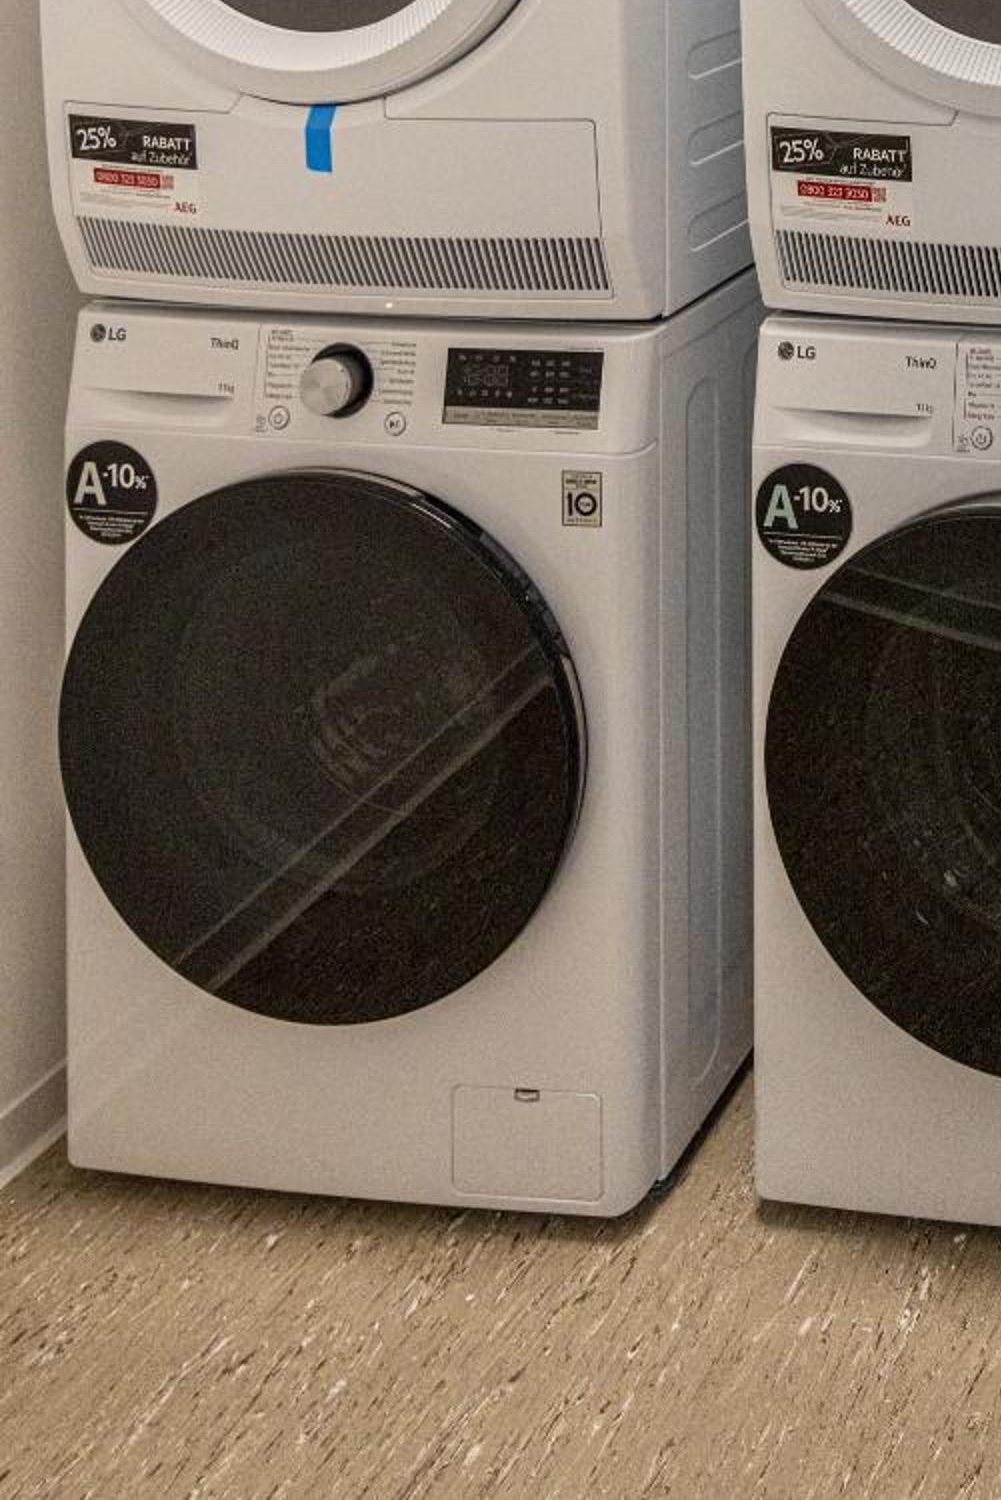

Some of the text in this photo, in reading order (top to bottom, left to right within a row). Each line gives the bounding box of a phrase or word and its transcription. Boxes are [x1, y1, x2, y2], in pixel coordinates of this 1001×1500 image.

[76, 126, 191, 152] 25% RABATT
[779, 138, 905, 163] 25% RABATT
[174, 201, 197, 214] AEG
[885, 215, 911, 227] AEG
[107, 327, 127, 341] LG
[210, 337, 239, 350] ThinQ
[797, 345, 816, 359] LG
[905, 356, 937, 369] ThinQ
[73, 461, 107, 506] A
[567, 492, 598, 517] 10
[763, 483, 799, 529] A
